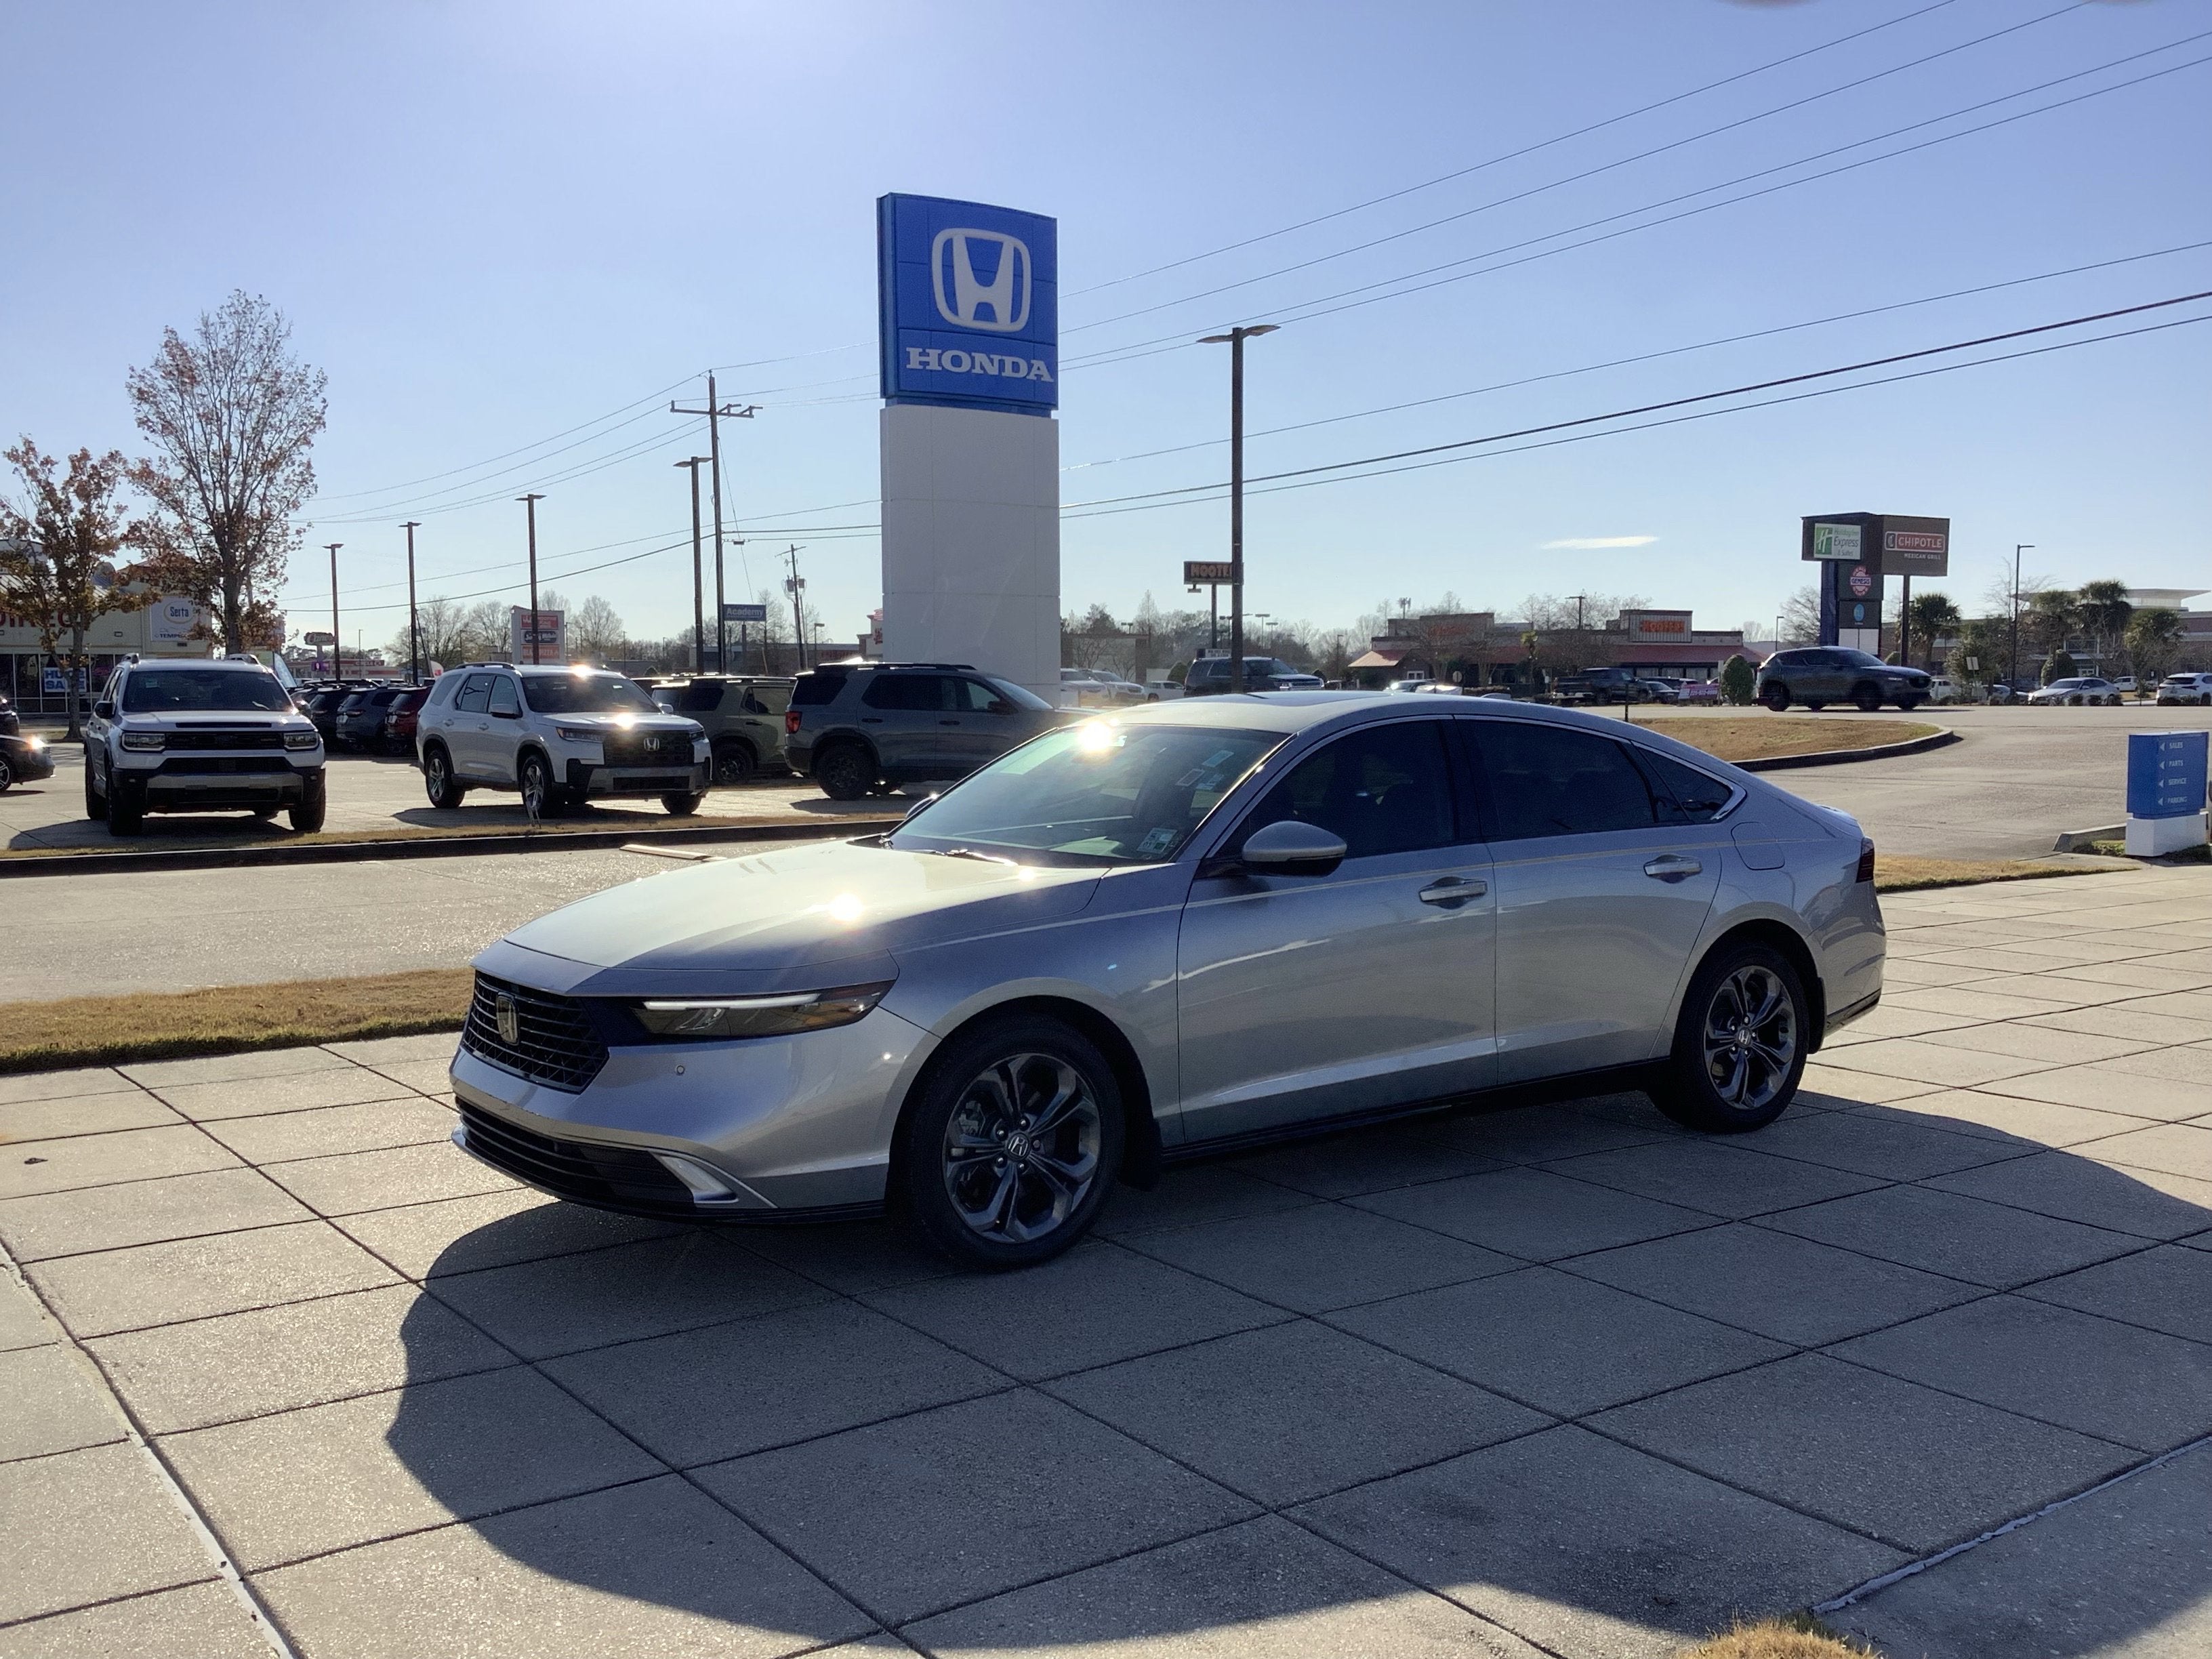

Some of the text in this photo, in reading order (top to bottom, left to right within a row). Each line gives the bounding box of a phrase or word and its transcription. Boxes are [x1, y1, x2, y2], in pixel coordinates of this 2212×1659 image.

[906, 347, 1054, 383] HONDA
[1834, 537, 1859, 548] Express
[1898, 537, 1942, 548] CHIPOTLE
[1191, 564, 1232, 578] HOOTE
[170, 607, 189, 617] Serta
[726, 607, 763, 618] Academy
[45, 670, 85, 679] HUE
[45, 680, 85, 690] SAE
